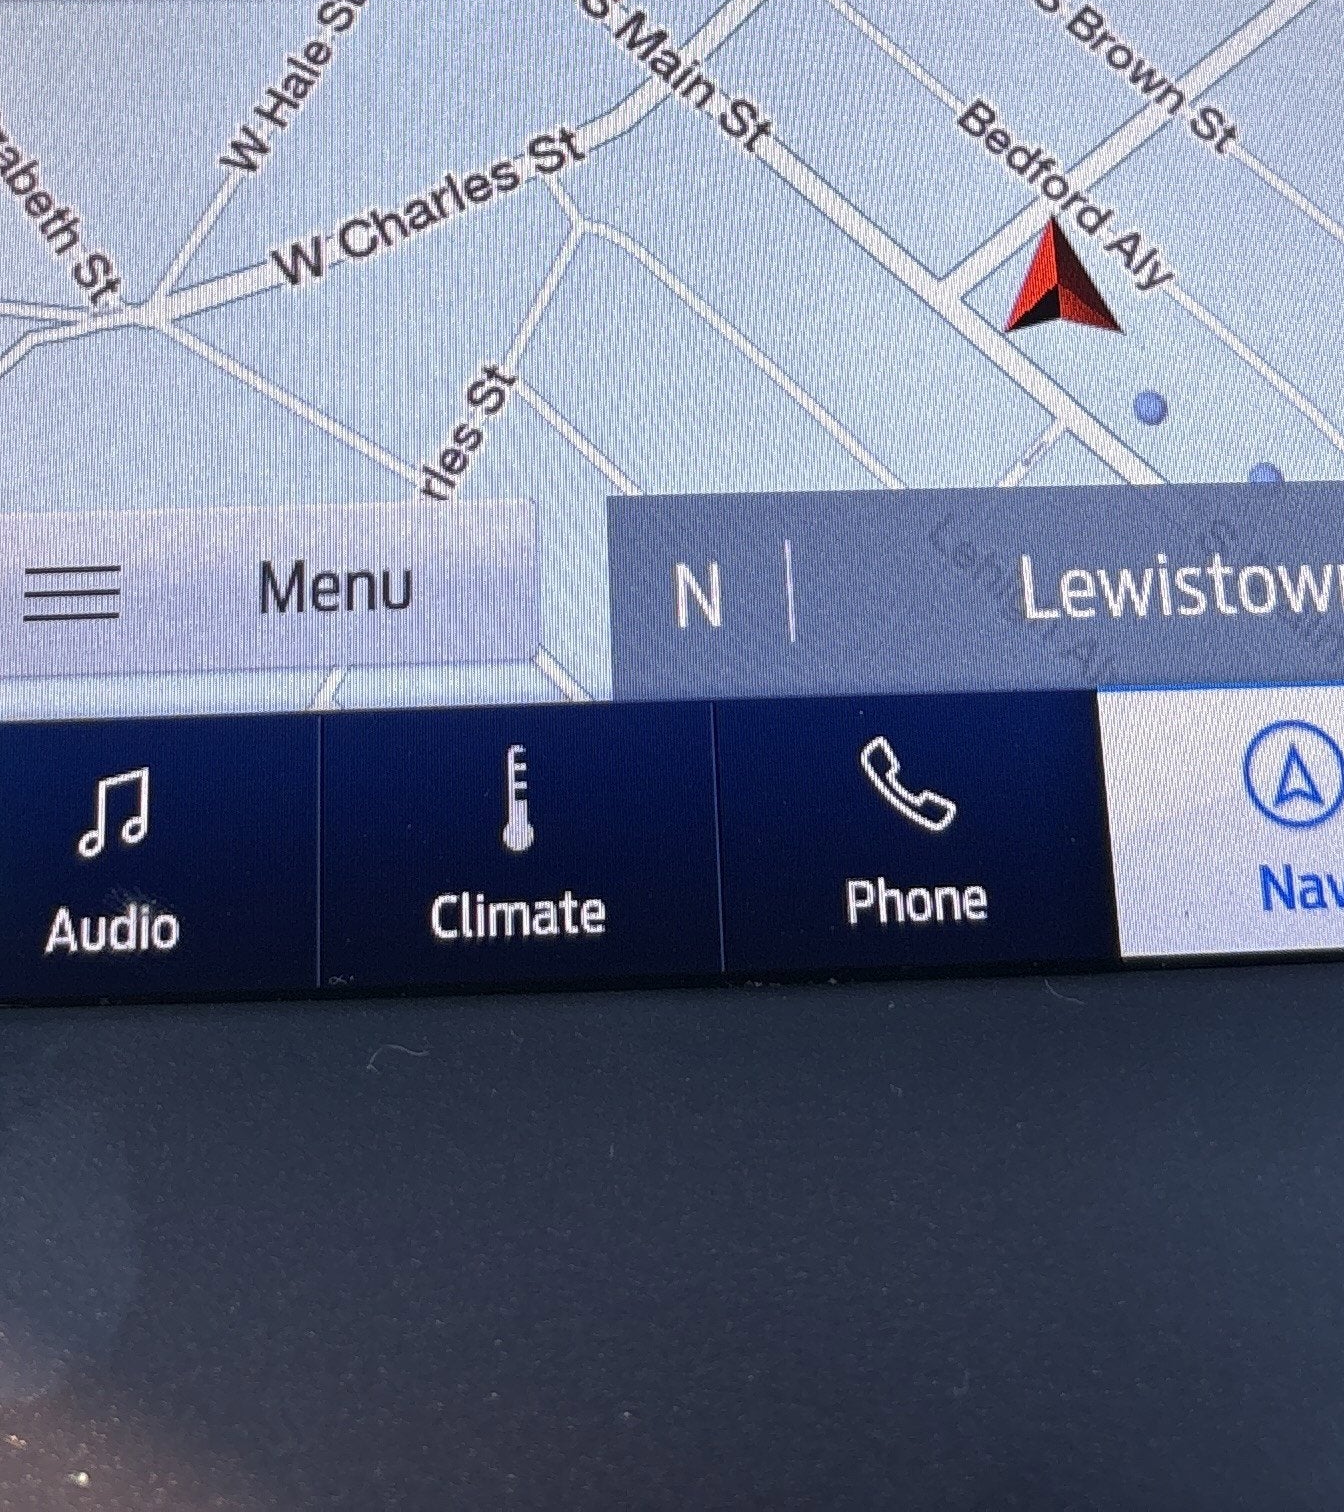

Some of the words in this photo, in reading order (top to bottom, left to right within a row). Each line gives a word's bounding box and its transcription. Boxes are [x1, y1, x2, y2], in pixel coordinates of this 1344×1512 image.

[219, 115, 270, 172] W
[253, 41, 332, 128] Hale
[613, 11, 718, 111] Main
[719, 95, 774, 153] St
[1066, 6, 1187, 114] Brown
[1188, 104, 1238, 155] St
[272, 234, 327, 288] W
[338, 152, 521, 263] Charles
[527, 124, 587, 175] St
[957, 98, 1113, 237] Bedford
[1104, 231, 1175, 293] Aly
[74, 253, 121, 306] St
[420, 424, 483, 501] rles
[468, 365, 517, 415] St
[260, 559, 413, 615] Menu
[675, 560, 721, 629] N
[45, 904, 181, 955] Audio
[430, 890, 607, 941] Climate
[847, 878, 988, 926] Phone
